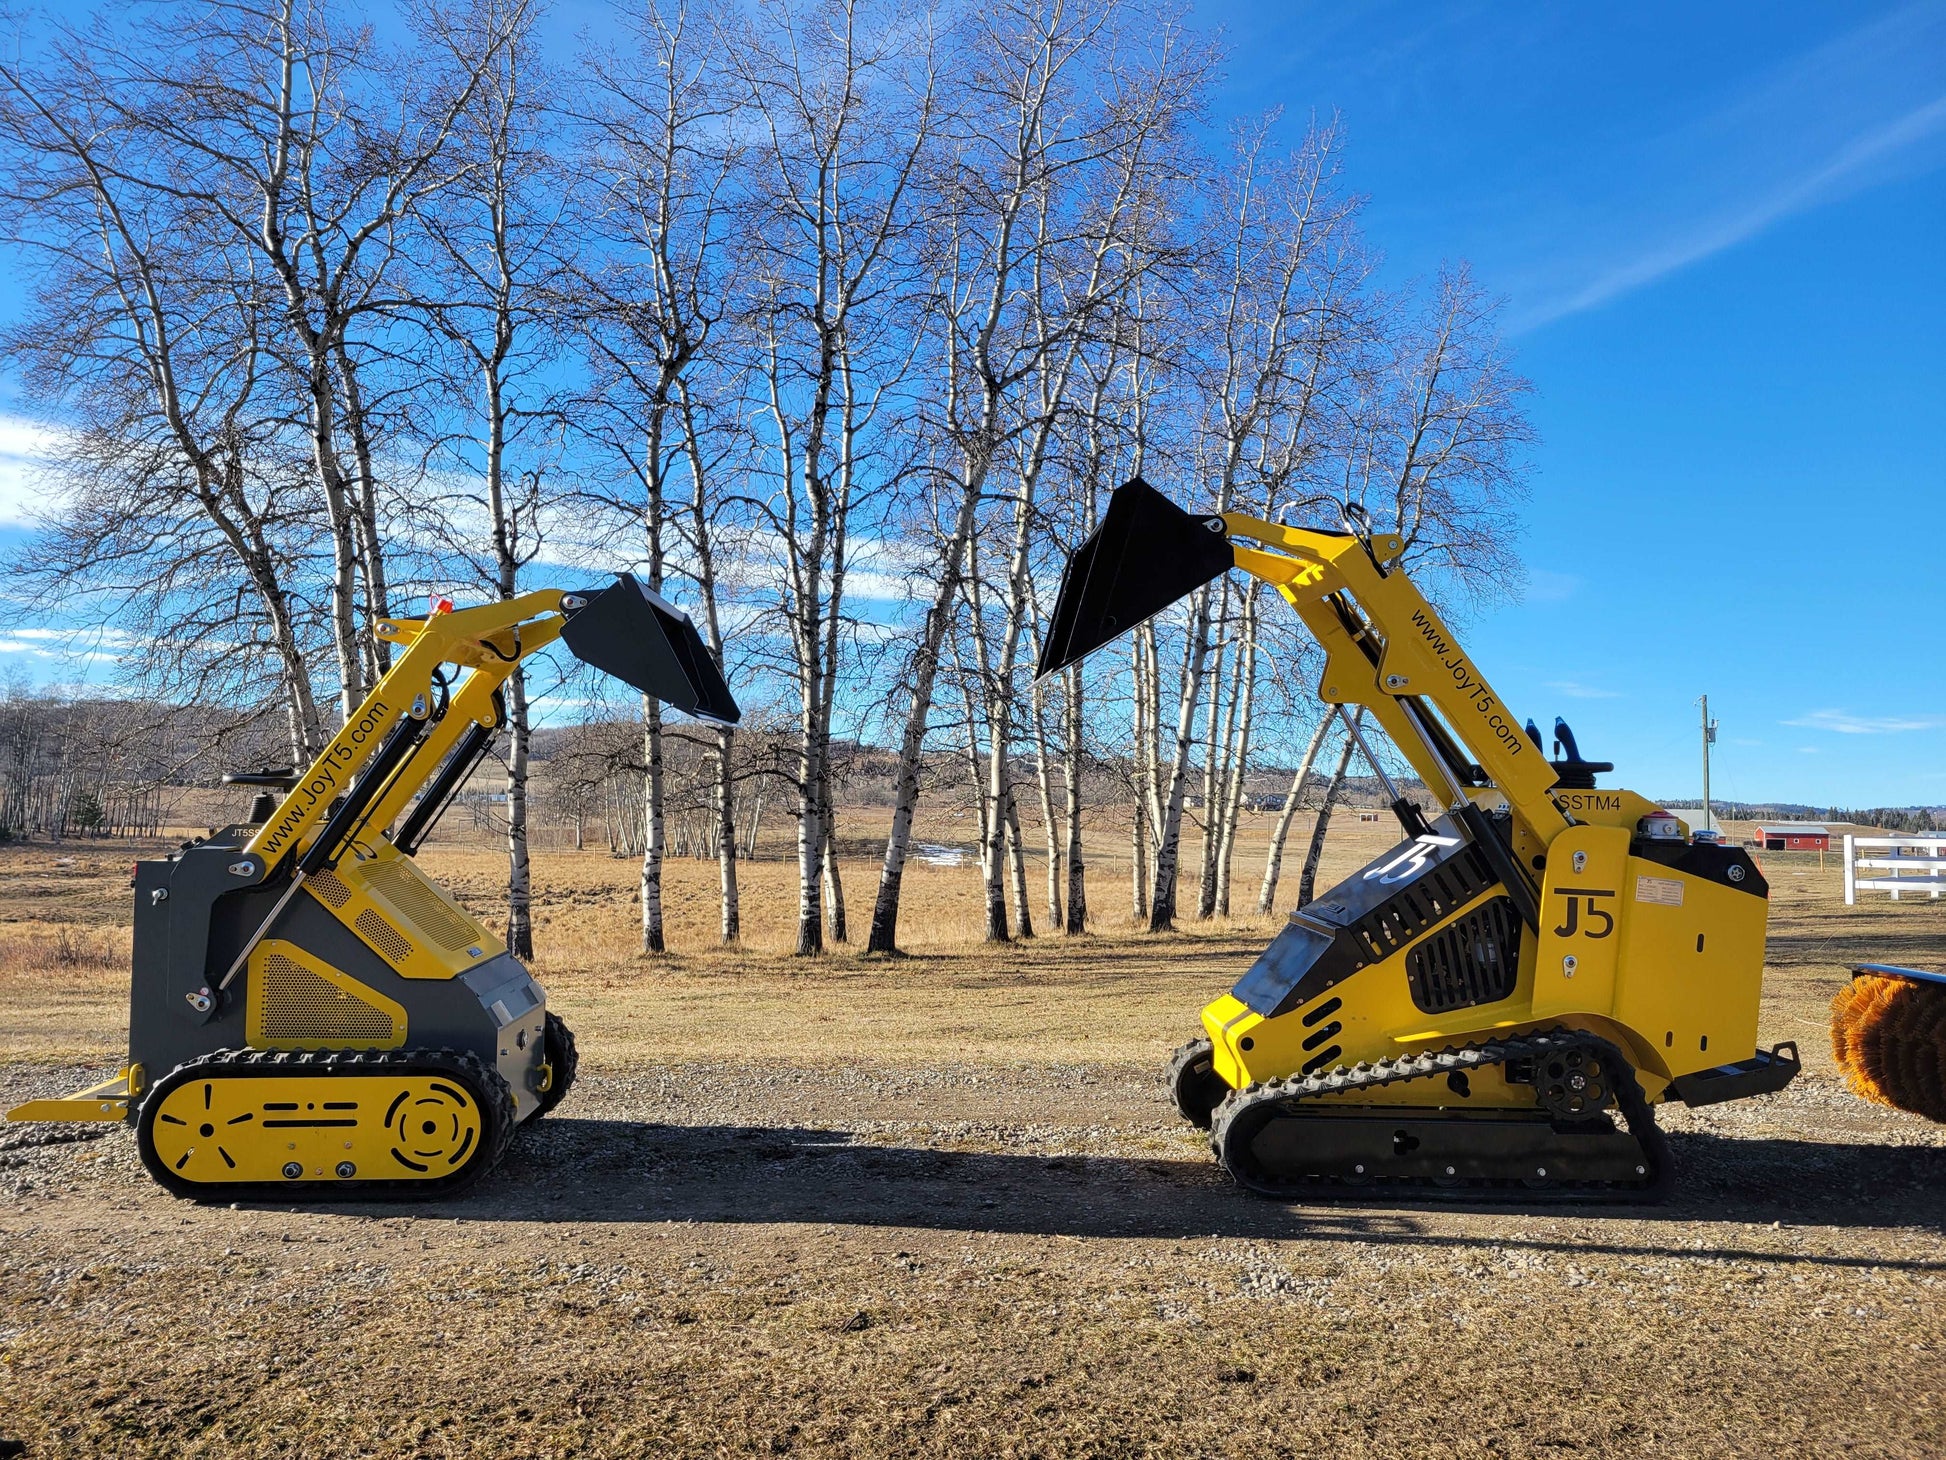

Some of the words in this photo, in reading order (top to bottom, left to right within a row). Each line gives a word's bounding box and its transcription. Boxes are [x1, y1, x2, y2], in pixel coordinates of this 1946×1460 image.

[1411, 609, 1522, 756] www.JoyT5.com
[262, 701, 389, 854] www.JoyT5.com
[1559, 794, 1621, 811] SSTM4
[1554, 888, 1615, 939] J5
